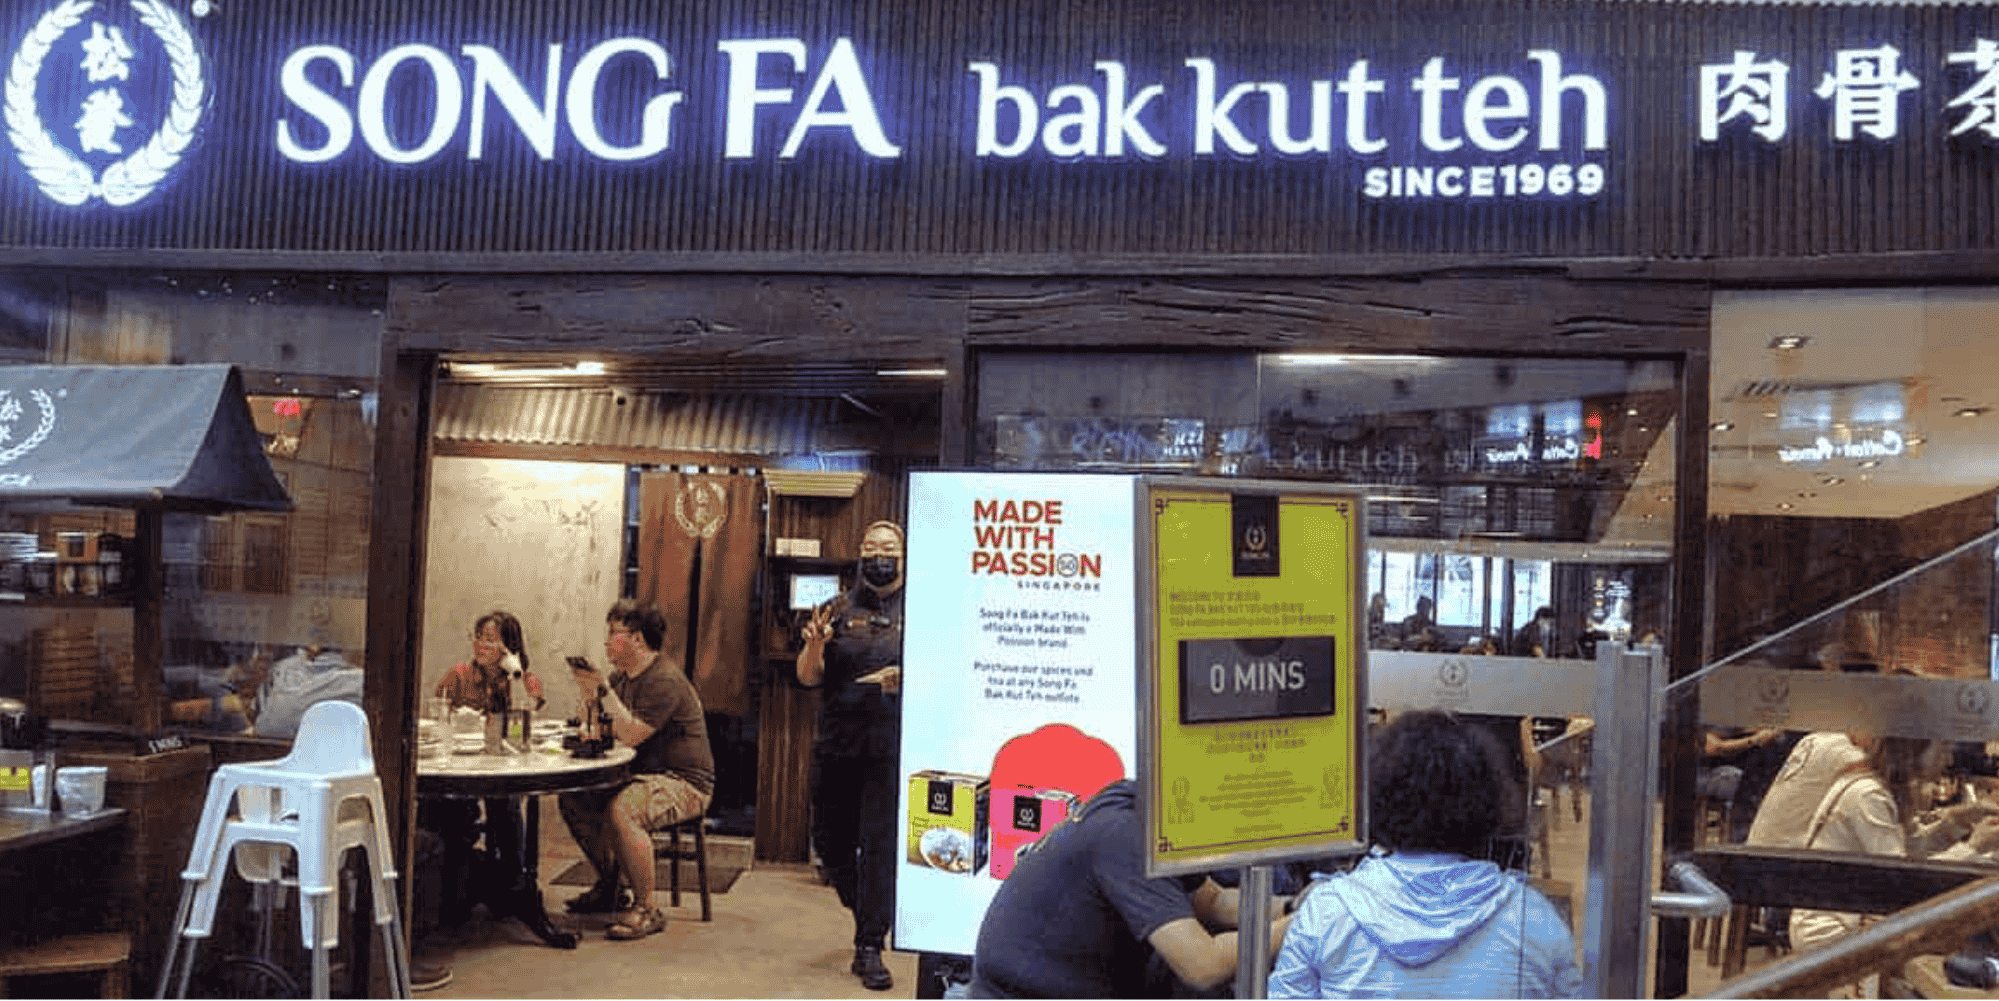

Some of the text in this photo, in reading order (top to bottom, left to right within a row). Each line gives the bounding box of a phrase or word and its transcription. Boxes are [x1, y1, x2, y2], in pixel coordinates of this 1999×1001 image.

[276, 36, 1607, 164] SONG FA bak kut teh
[974, 499, 1062, 524] MADE
[974, 525, 1054, 550] WITH
[1017, 580, 1100, 591] SINGAPORE
[1234, 661, 1305, 693] MINS
